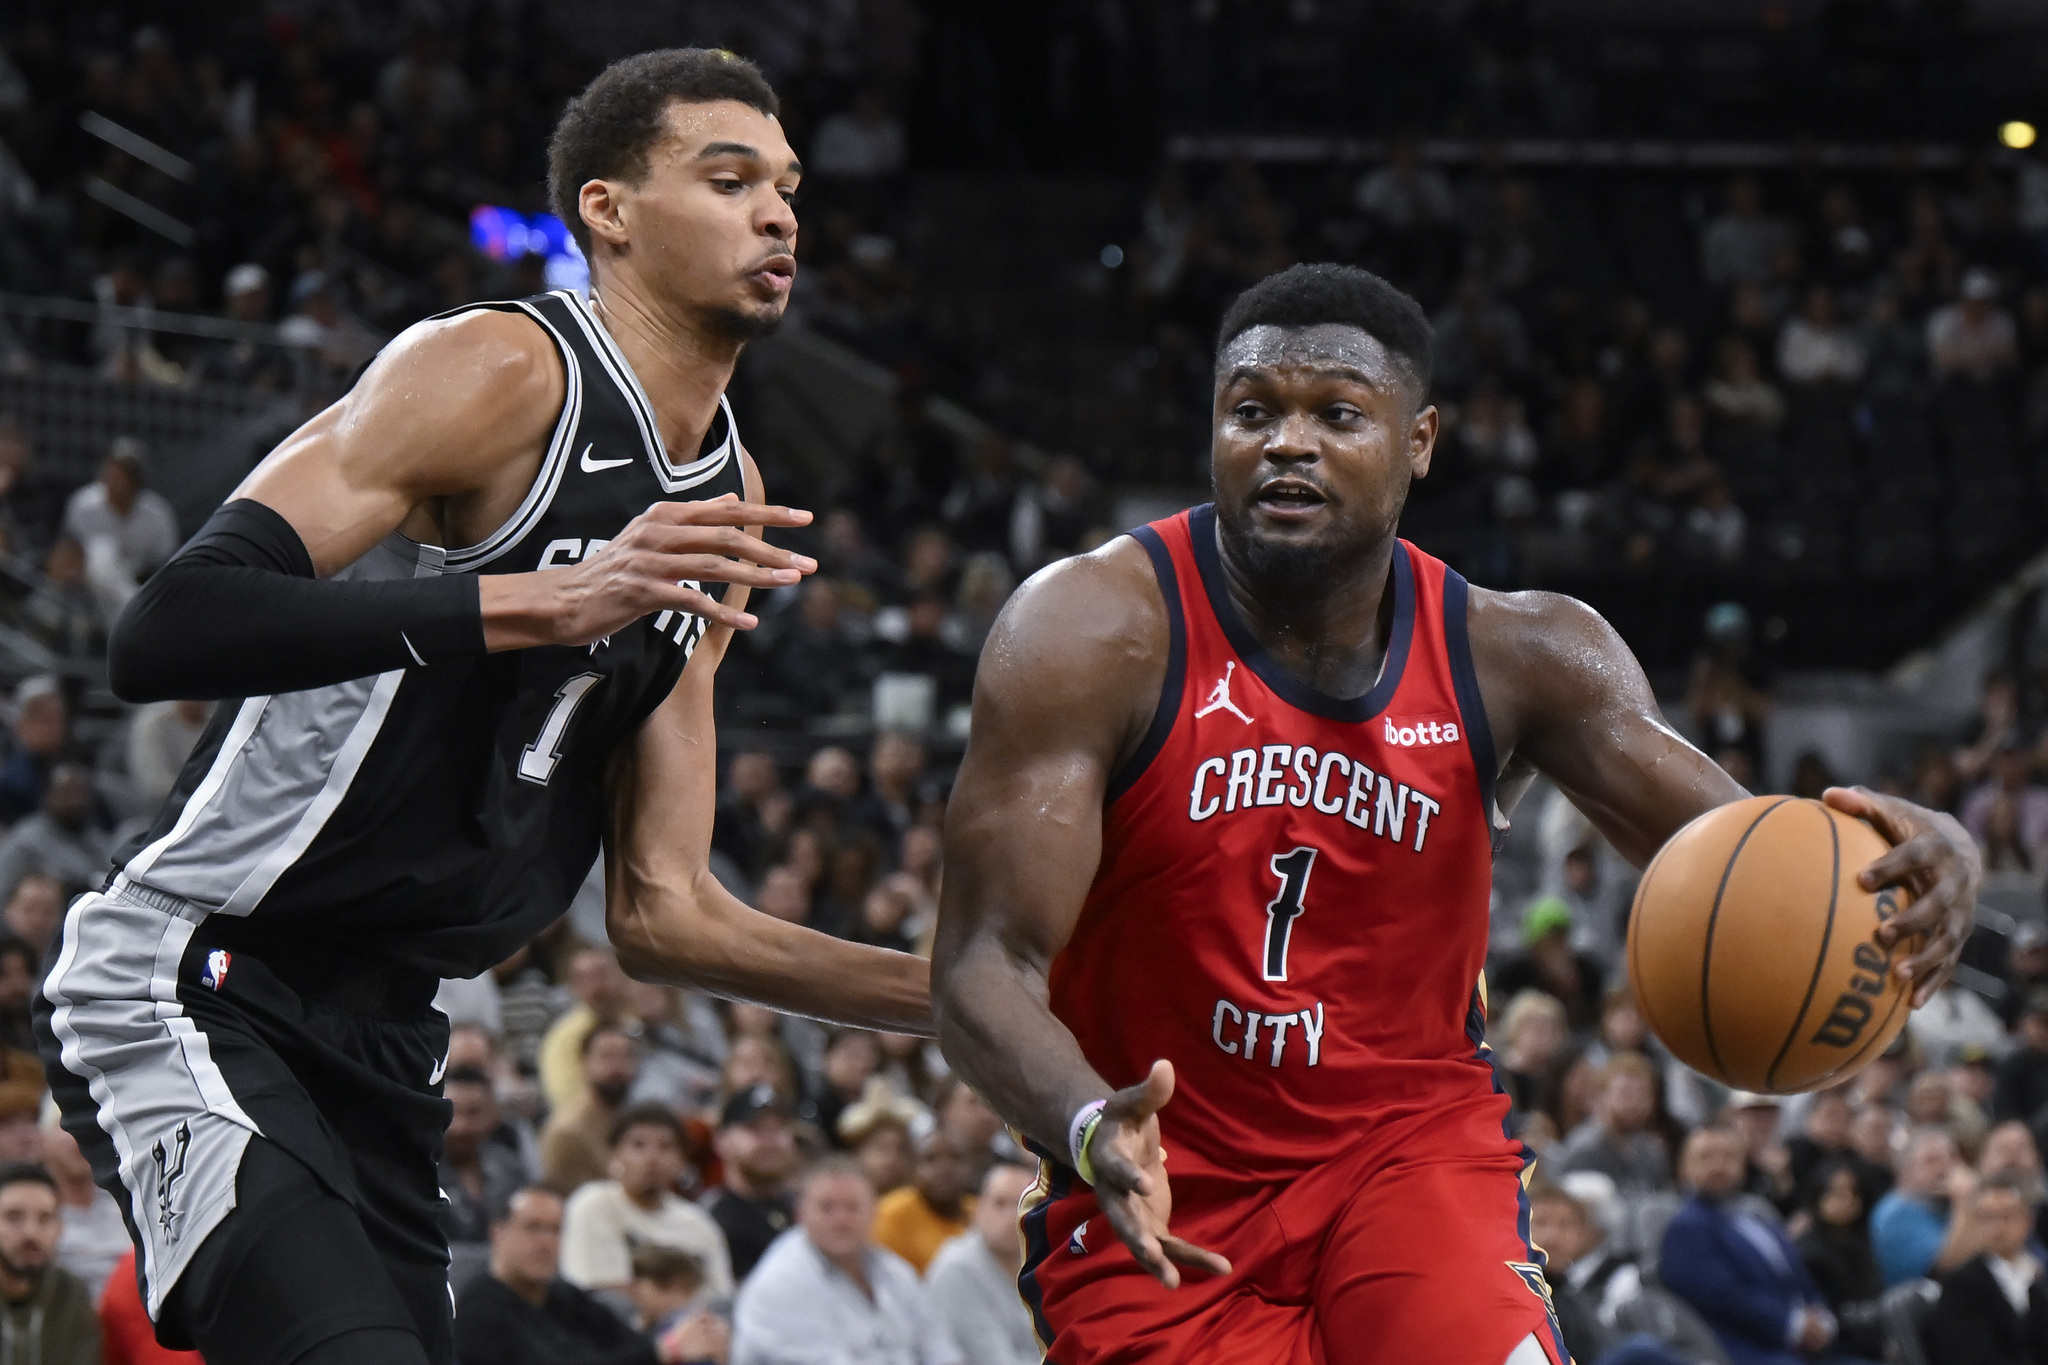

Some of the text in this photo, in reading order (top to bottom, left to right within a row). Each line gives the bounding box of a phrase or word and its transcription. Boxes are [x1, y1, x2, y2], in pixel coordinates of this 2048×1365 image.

[517, 671, 605, 786] 1
[1385, 714, 1460, 747] ibotta
[1188, 744, 1440, 852] CRESCENT
[1263, 846, 1318, 981] 1
[1212, 999, 1324, 1067] CITY
